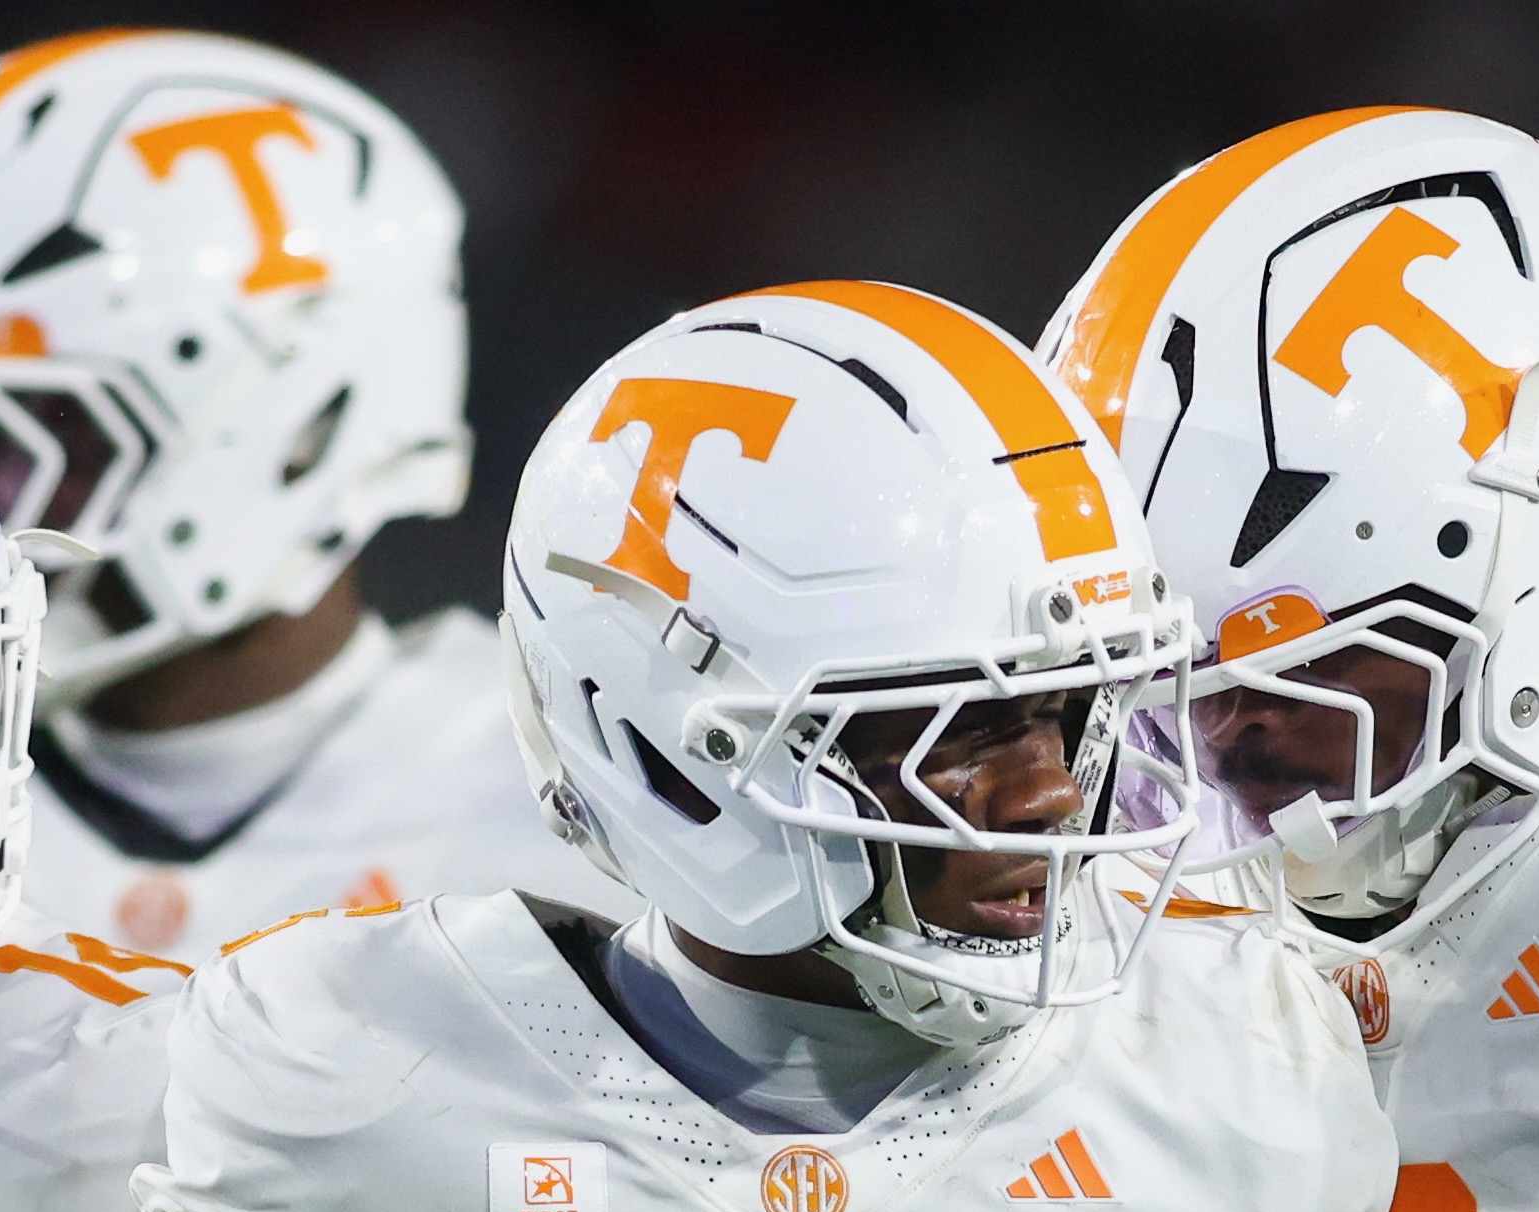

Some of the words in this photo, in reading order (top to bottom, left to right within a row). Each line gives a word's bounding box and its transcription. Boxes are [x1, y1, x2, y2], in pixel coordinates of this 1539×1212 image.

[129, 104, 326, 295] T
[1271, 205, 1534, 463] T
[588, 377, 798, 603] T
[1244, 601, 1282, 635] T
